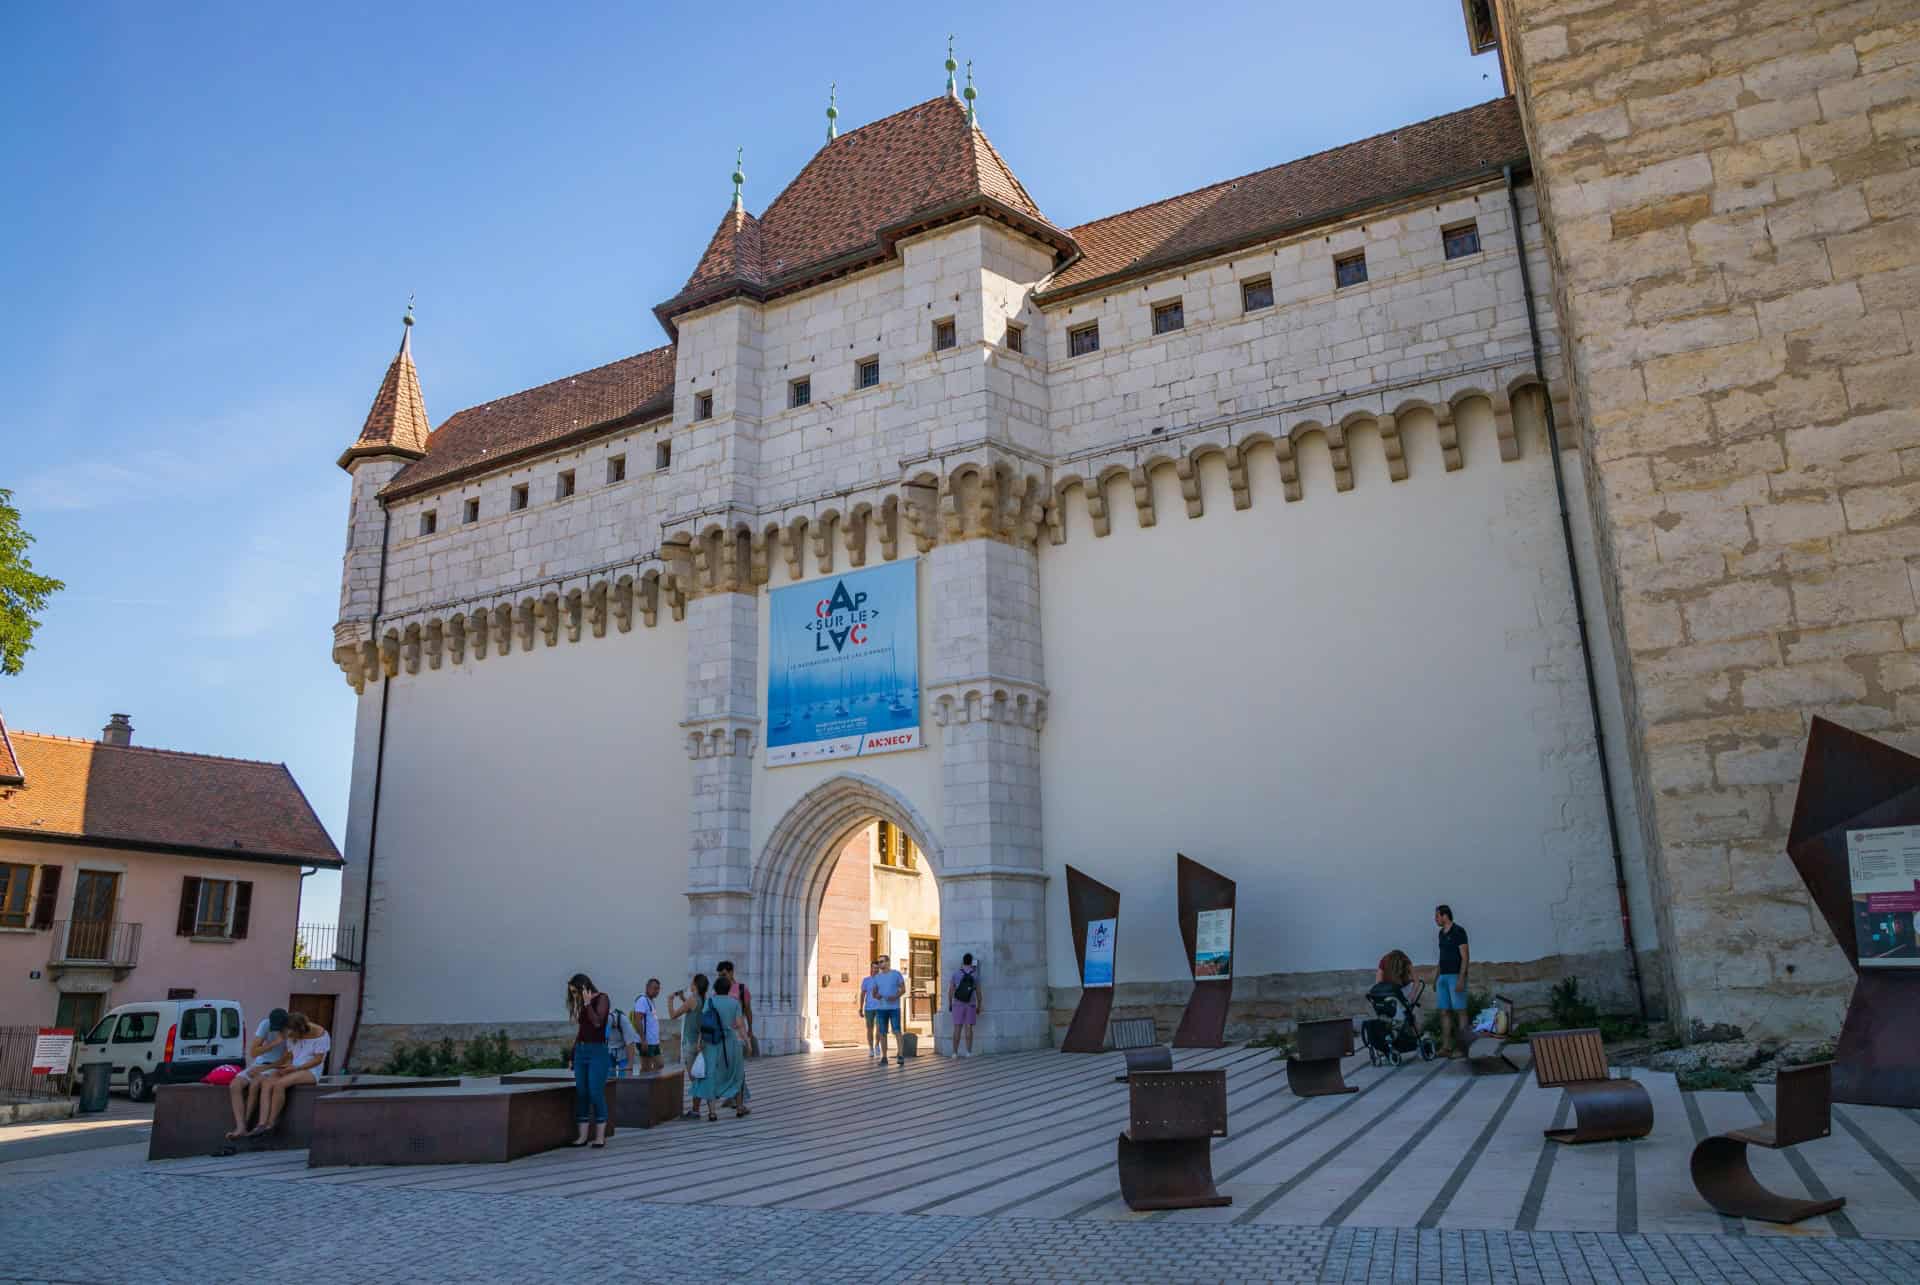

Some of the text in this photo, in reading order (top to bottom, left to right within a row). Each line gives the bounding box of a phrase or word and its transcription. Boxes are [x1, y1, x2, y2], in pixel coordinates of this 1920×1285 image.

[815, 579, 868, 619] CAP
[816, 610, 868, 631] SUR LE
[815, 624, 868, 655] LAC
[868, 733, 913, 748] ANNECY
